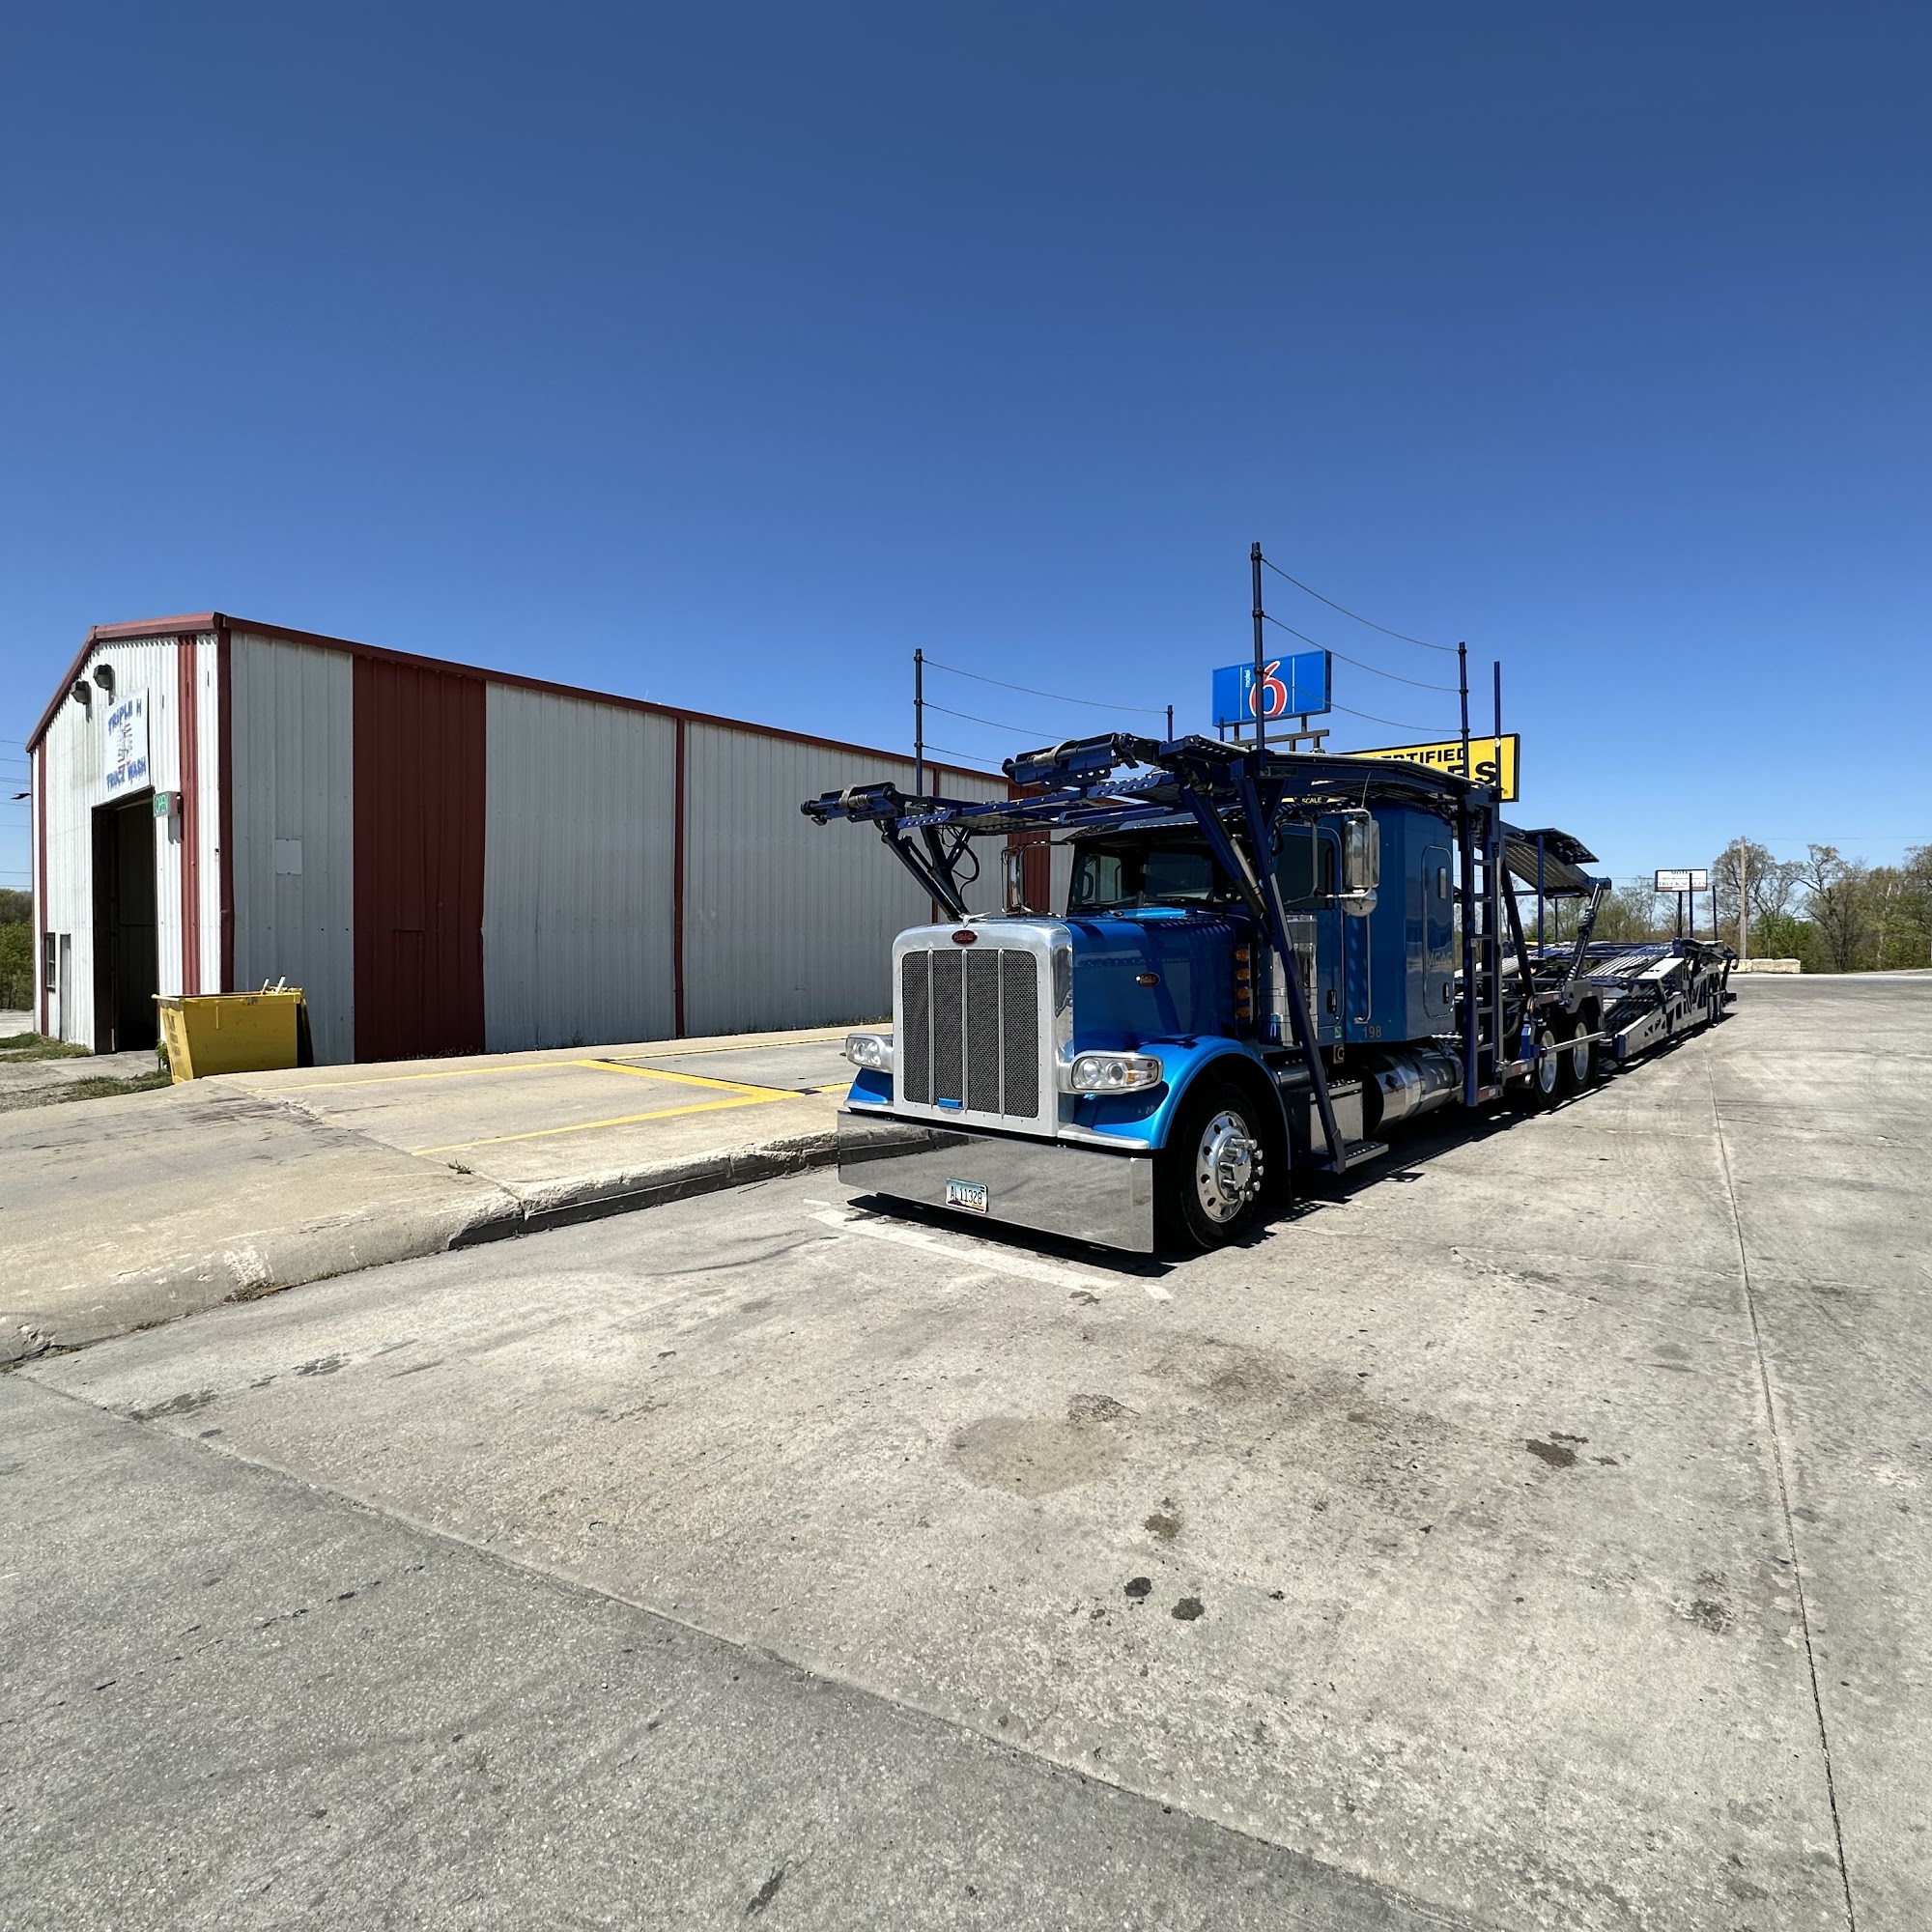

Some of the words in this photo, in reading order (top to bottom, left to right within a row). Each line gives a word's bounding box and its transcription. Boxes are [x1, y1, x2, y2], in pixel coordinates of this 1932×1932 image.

[1249, 661, 1288, 717] 6
[108, 700, 133, 736] TRIPLE
[136, 698, 142, 717] H
[128, 755, 147, 784] WASH
[1362, 1025, 1382, 1038] 198
